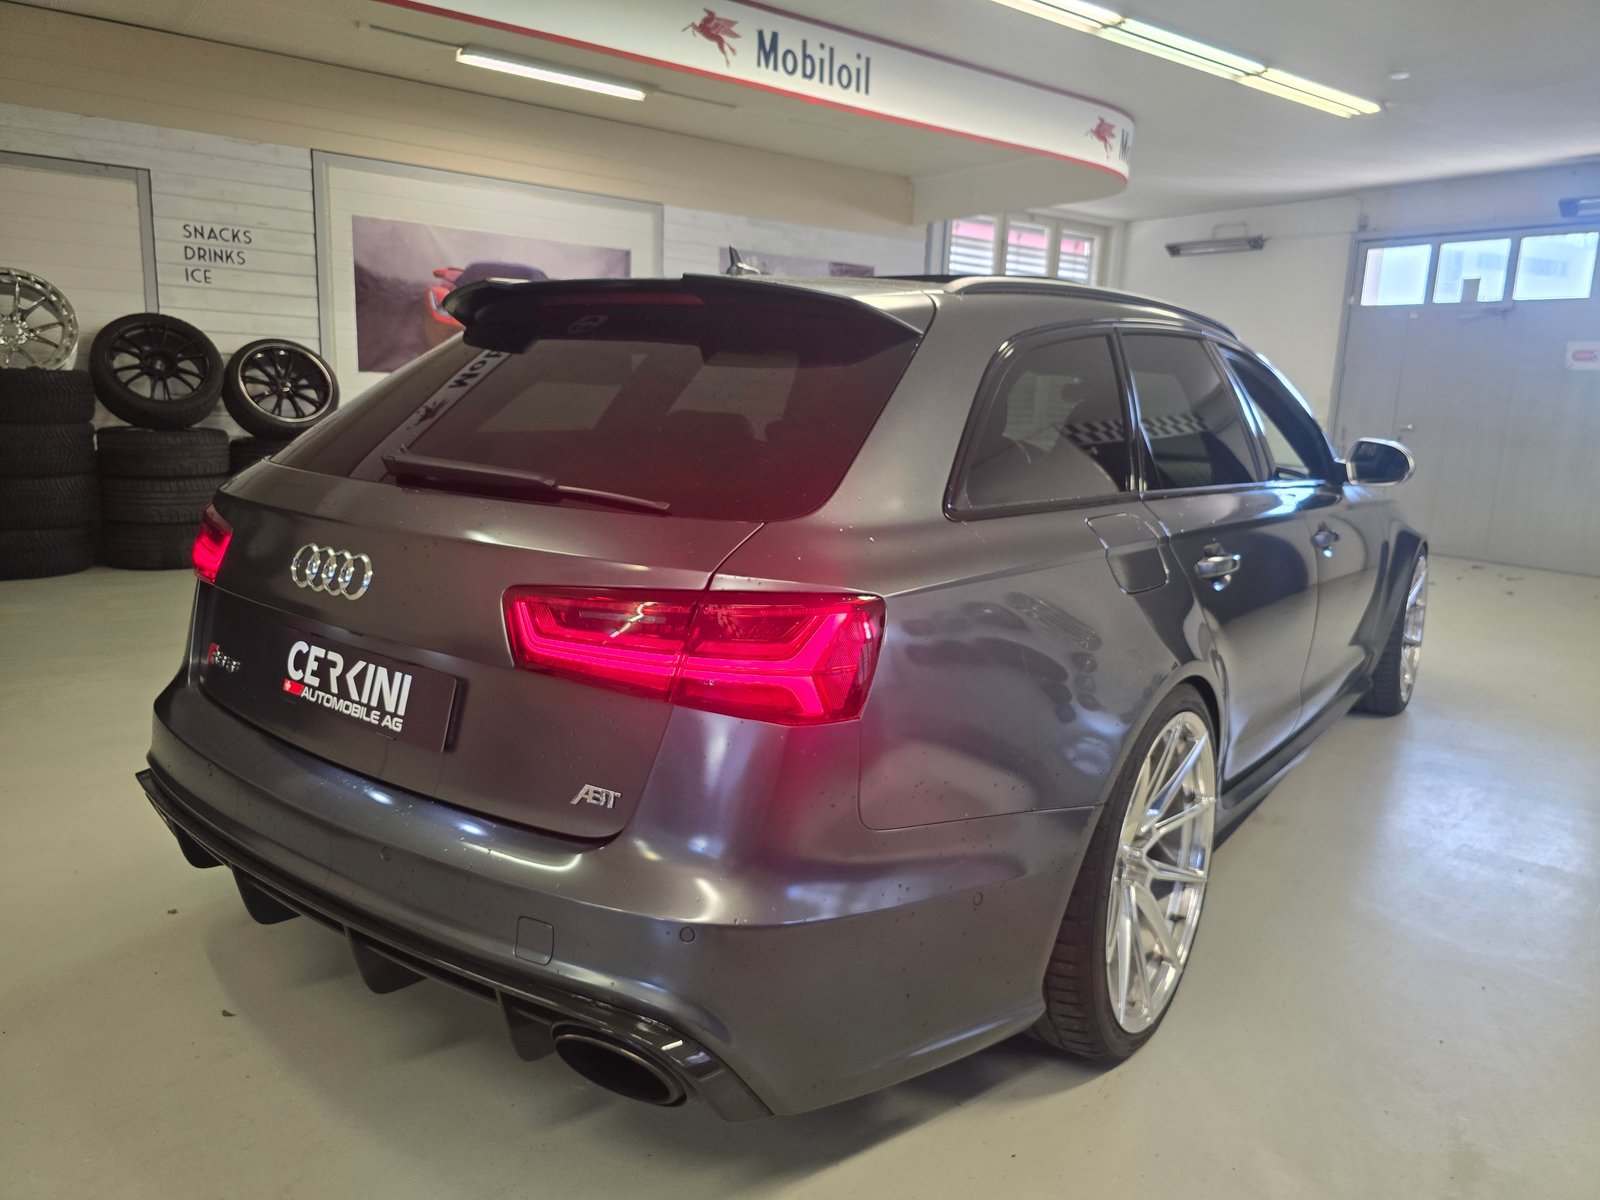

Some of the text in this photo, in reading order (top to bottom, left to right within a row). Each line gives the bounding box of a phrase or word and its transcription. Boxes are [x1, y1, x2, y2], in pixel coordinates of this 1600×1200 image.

[757, 30, 870, 94] Mobiloil
[183, 224, 252, 244] SNACKS
[184, 246, 245, 265] DRINKS
[185, 267, 212, 284] ICE
[287, 641, 412, 716] CERKINI
[301, 687, 403, 732] AUTOMOBILE AG
[570, 784, 621, 808] ABT
